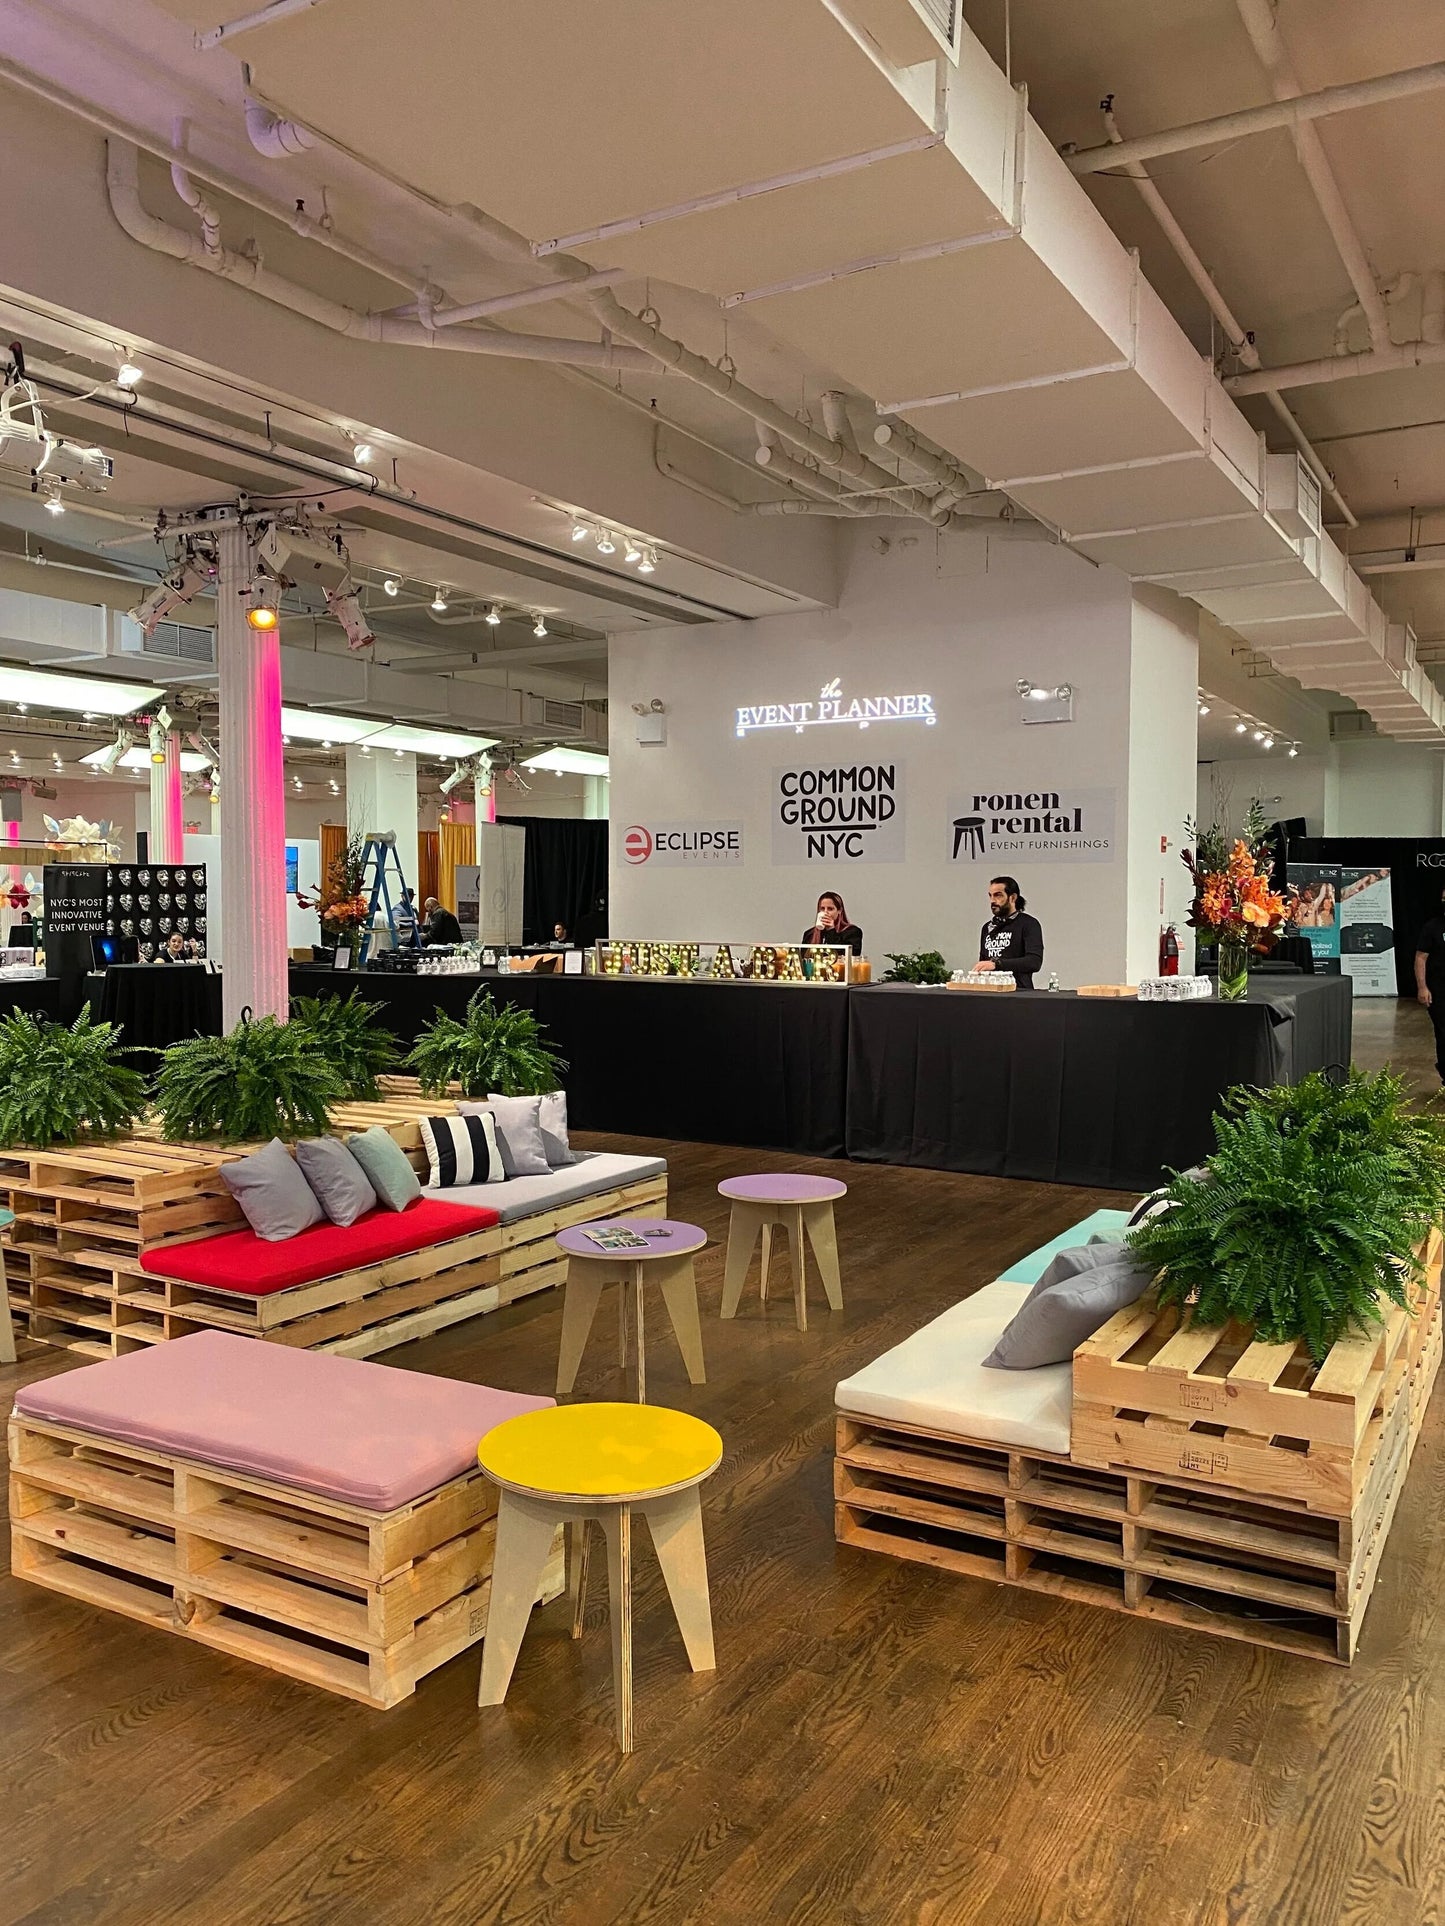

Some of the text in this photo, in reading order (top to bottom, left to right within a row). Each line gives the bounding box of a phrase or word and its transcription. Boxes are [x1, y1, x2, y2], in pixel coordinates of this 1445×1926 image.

[820, 676, 843, 699] the
[736, 694, 935, 726] EVENT PLANNER
[780, 765, 895, 797] COMMON
[780, 794, 896, 825] GROUND
[971, 792, 1061, 812] ronen
[989, 808, 1083, 835] rental
[655, 831, 740, 851] ECLIPSE
[807, 832, 864, 859] NYC
[990, 839, 1109, 850] EVENT FURNISHINGS
[683, 851, 740, 860] EVENTS
[50, 898, 103, 907] NYC'S MOST
[51, 910, 103, 920] INNOVATIVE
[48, 922, 105, 932] EVENT VENUE
[985, 931, 1013, 942] CMON
[984, 939, 1011, 950] GROUND
[988, 949, 1002, 958] NYC
[604, 941, 700, 977] JUST
[709, 944, 736, 979] A
[750, 945, 840, 982] BAR
